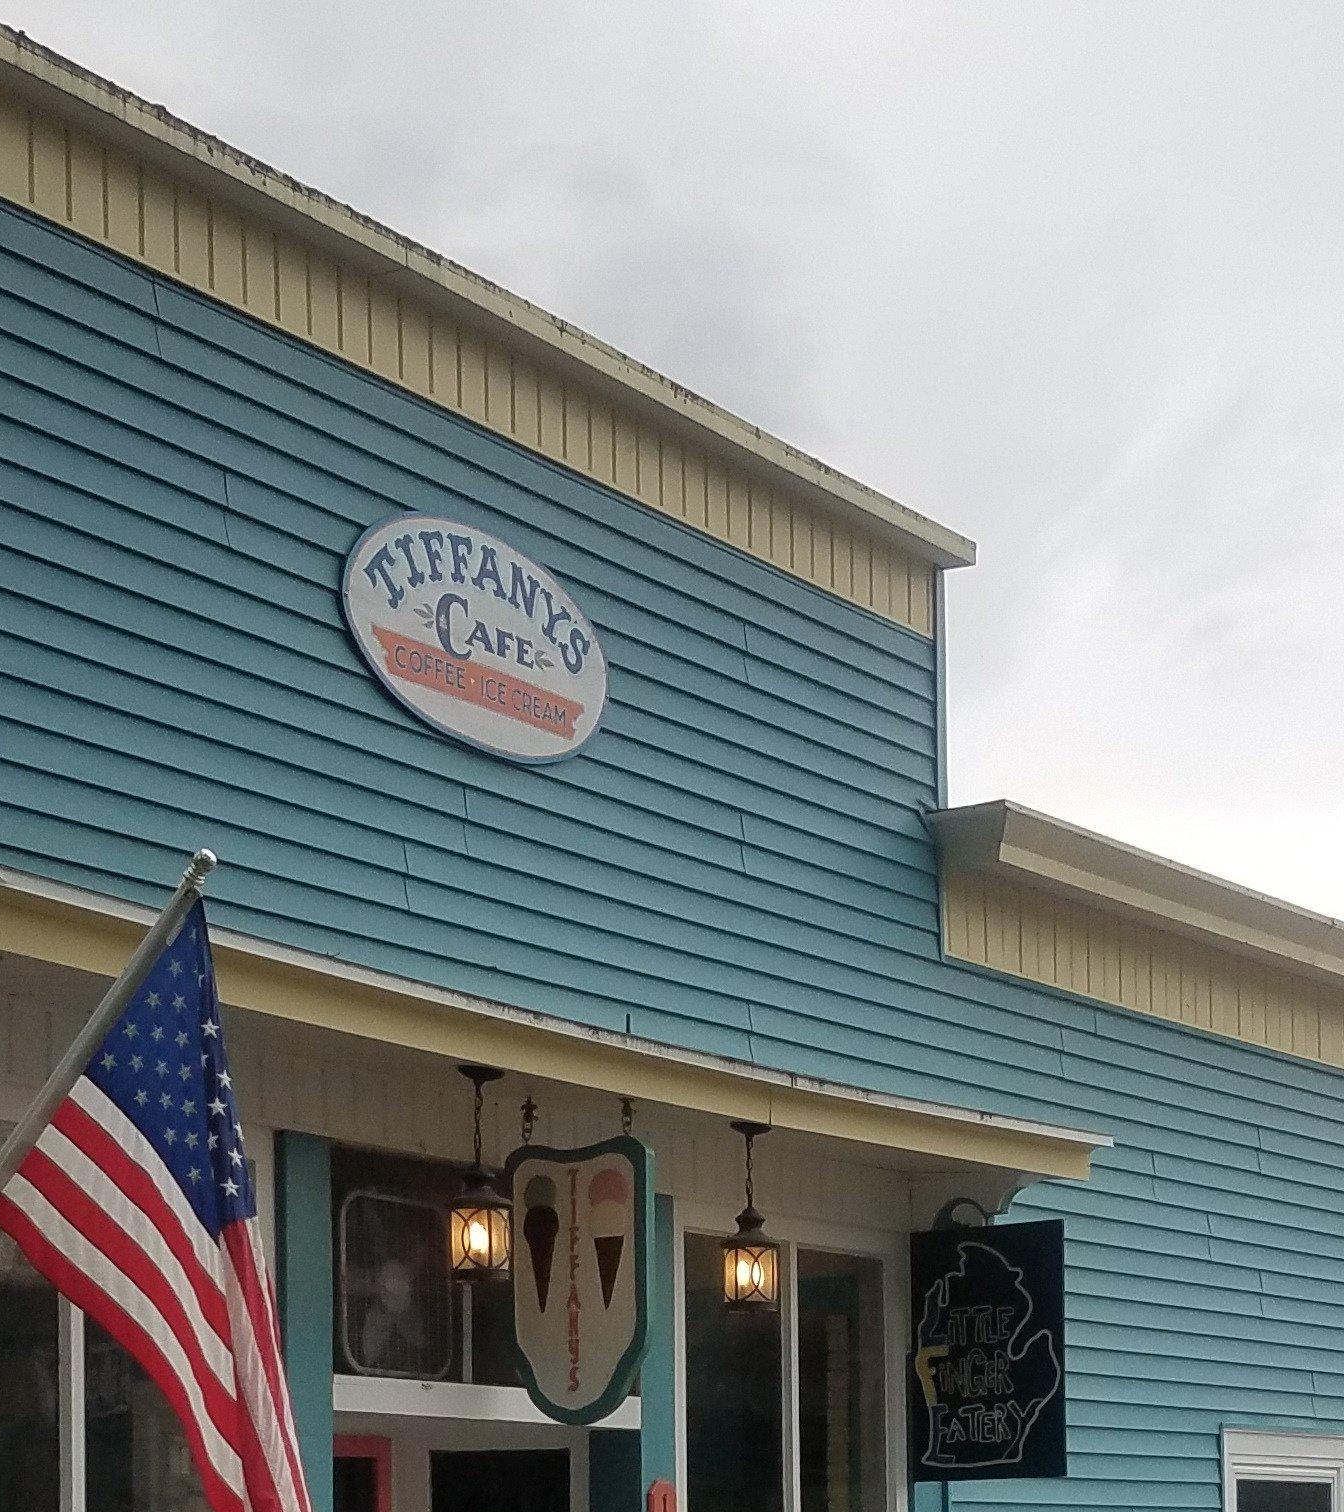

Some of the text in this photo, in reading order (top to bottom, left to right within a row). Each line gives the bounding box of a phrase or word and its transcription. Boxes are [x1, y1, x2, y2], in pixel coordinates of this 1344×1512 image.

[435, 592, 535, 670] CAFE
[395, 644, 567, 728] COFFEE ICE CREAM
[929, 1399, 1044, 1464] EATERY
